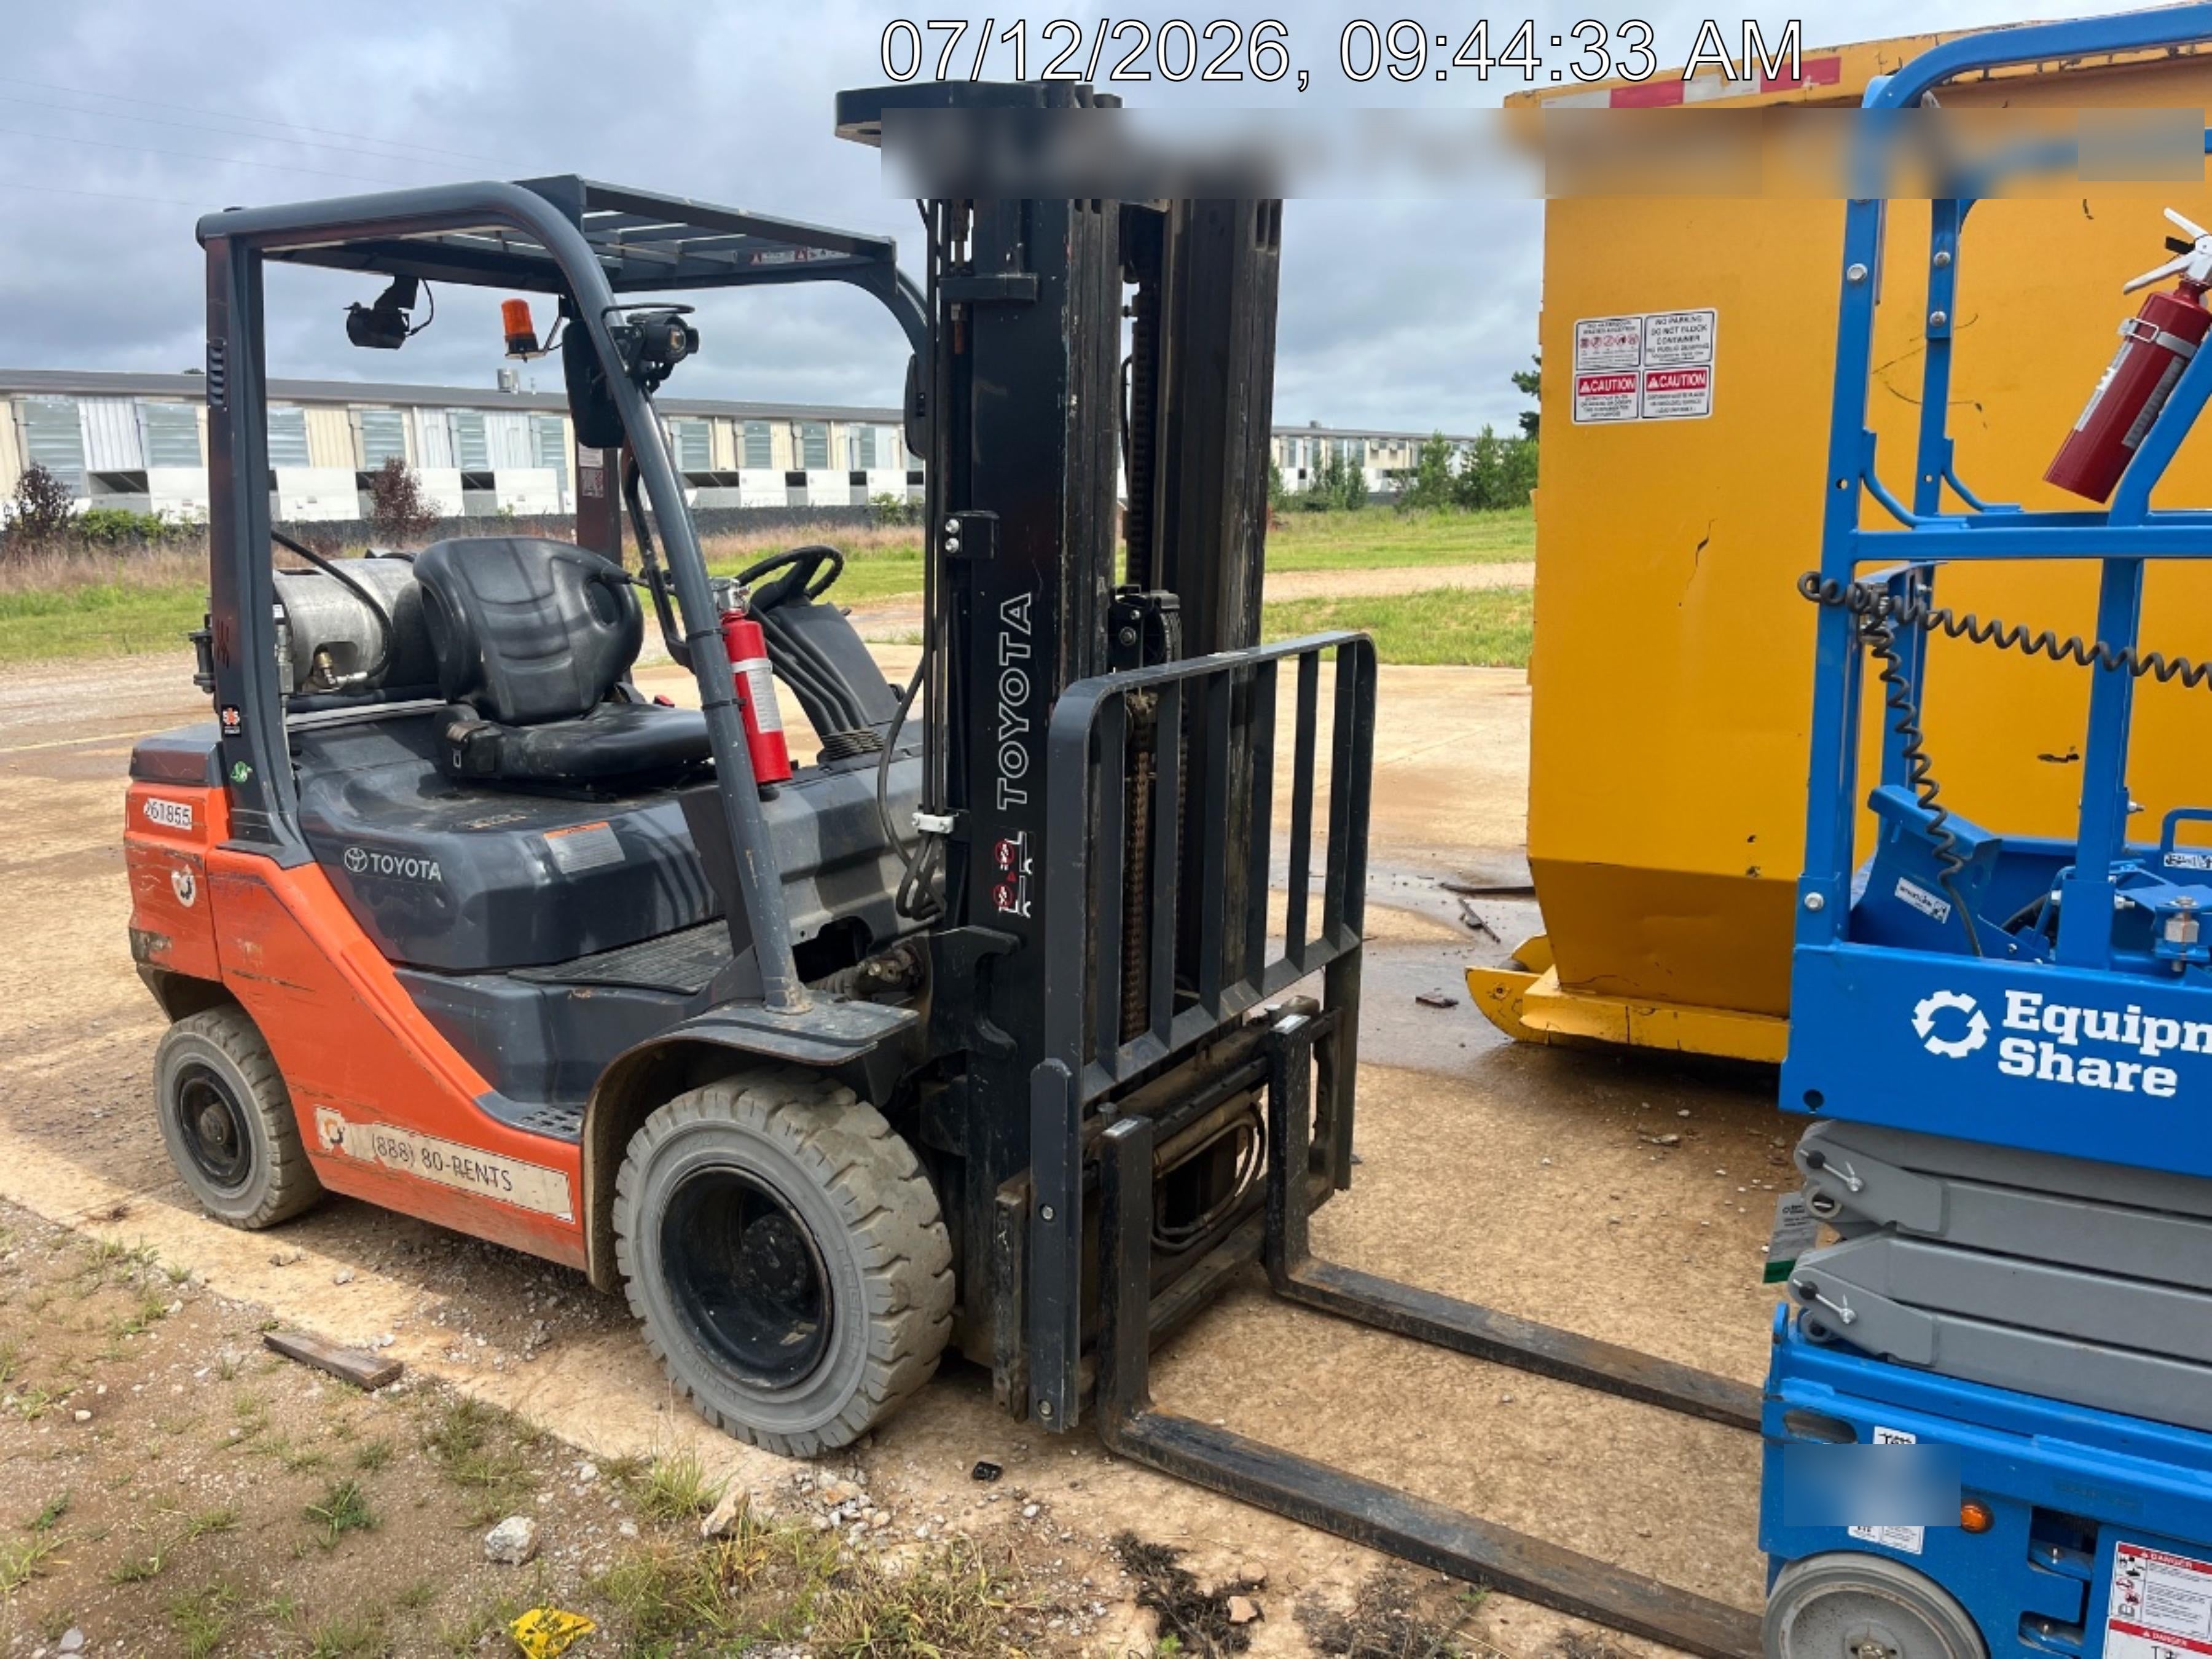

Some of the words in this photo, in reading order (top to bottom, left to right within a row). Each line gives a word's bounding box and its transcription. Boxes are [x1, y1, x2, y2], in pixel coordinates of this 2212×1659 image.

[1657, 335, 1700, 345] CONTAINER
[1590, 378, 1635, 392] CAUTION
[1660, 372, 1706, 388] CAUTION
[997, 592, 1031, 810] TOYOTA
[370, 853, 442, 881] TOYOTA
[1998, 1037, 2178, 1097] Share
[372, 1133, 415, 1167] (888)
[422, 1148, 513, 1192] 80-RENTS
